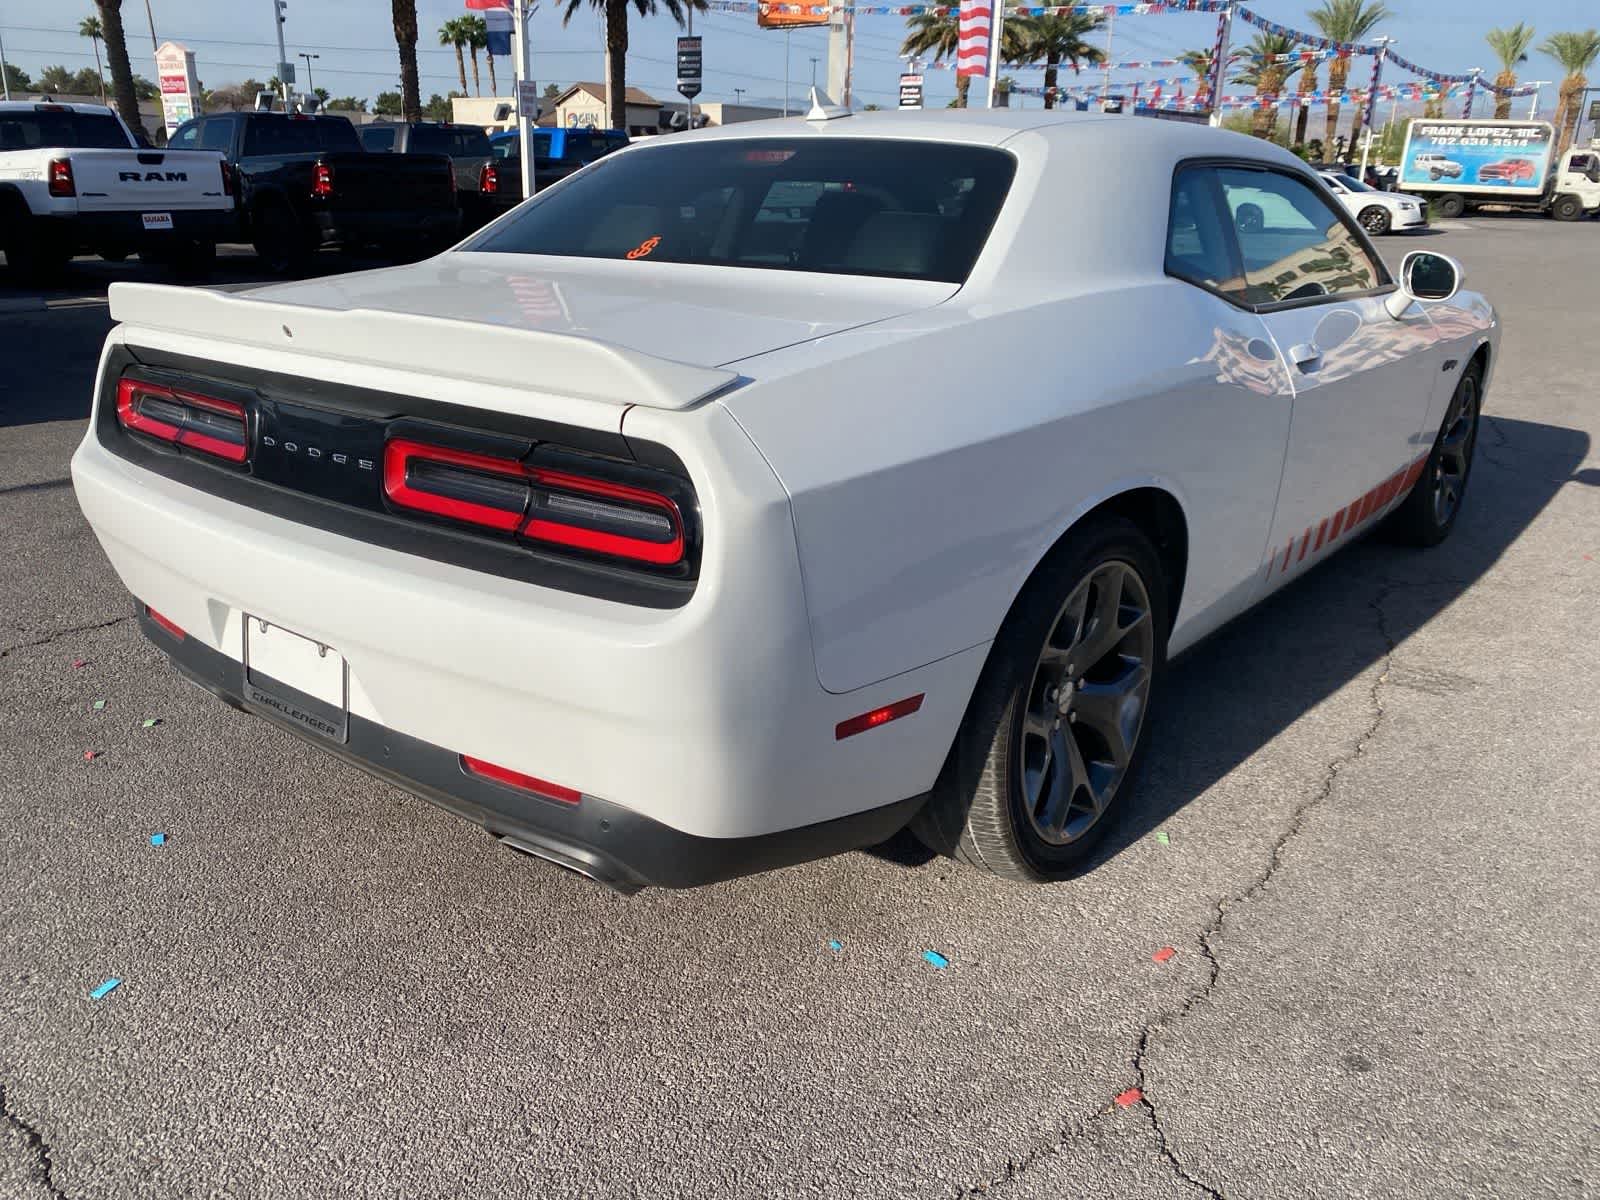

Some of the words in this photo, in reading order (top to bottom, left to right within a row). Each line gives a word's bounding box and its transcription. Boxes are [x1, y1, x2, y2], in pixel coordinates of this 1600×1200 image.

[119, 171, 188, 182] RAM
[263, 435, 374, 471] DODGE
[251, 691, 336, 736] CHALLENGER
